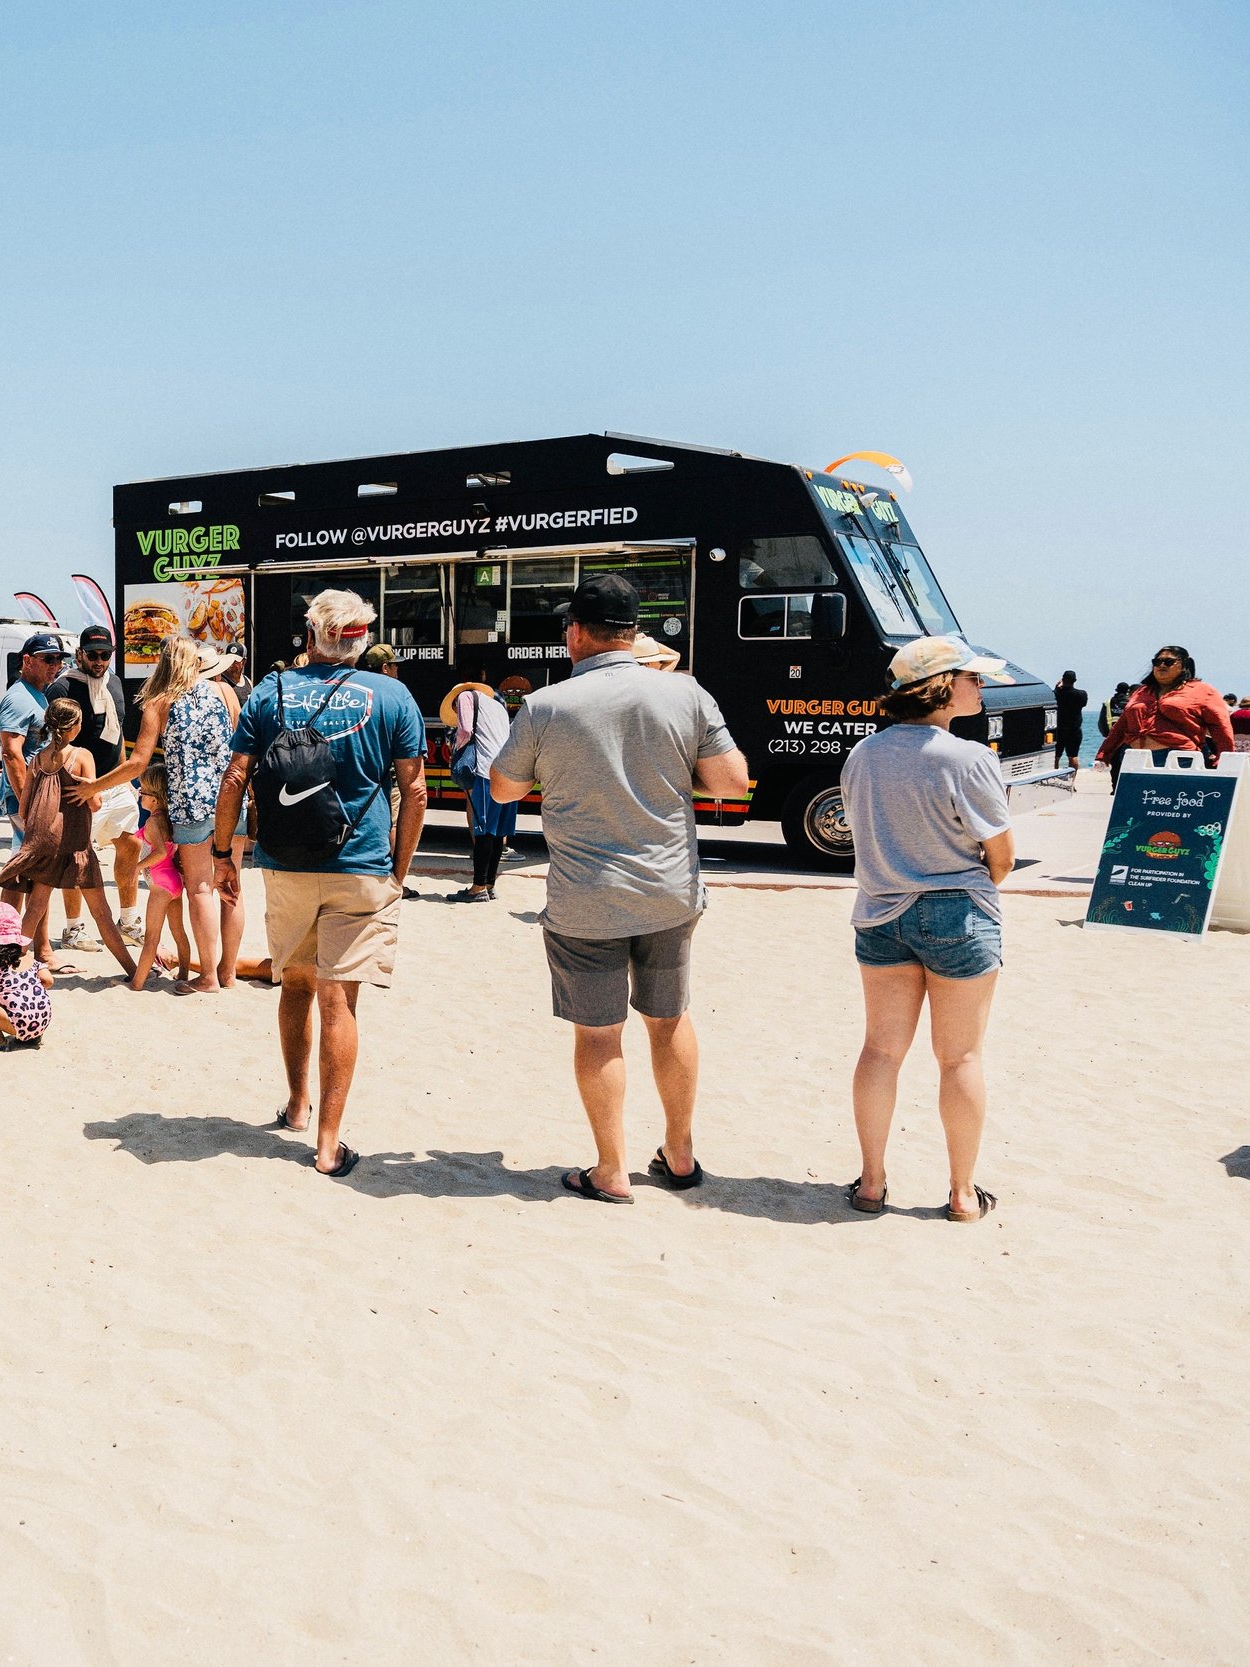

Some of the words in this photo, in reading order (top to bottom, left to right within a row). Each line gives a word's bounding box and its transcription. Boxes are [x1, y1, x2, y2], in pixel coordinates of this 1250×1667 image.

[275, 528, 348, 549] FOLLOW
[351, 517, 491, 546] @VURGERGUYZ
[495, 506, 639, 533] #VURGERFIED
[136, 524, 241, 556] VURGER
[153, 553, 222, 583] GUYZ
[480, 570, 490, 582] A
[403, 648, 417, 660] UP
[418, 647, 444, 660] HERE
[507, 646, 543, 659] ORDER
[766, 699, 845, 716] VURGER
[784, 721, 814, 735] WE
[817, 721, 878, 736] CATER
[768, 739, 806, 755] (213)
[810, 740, 841, 754] 298
[1142, 789, 1172, 806] Free
[1174, 791, 1221, 810] food
[1142, 869, 1178, 877] PARTICIPATION
